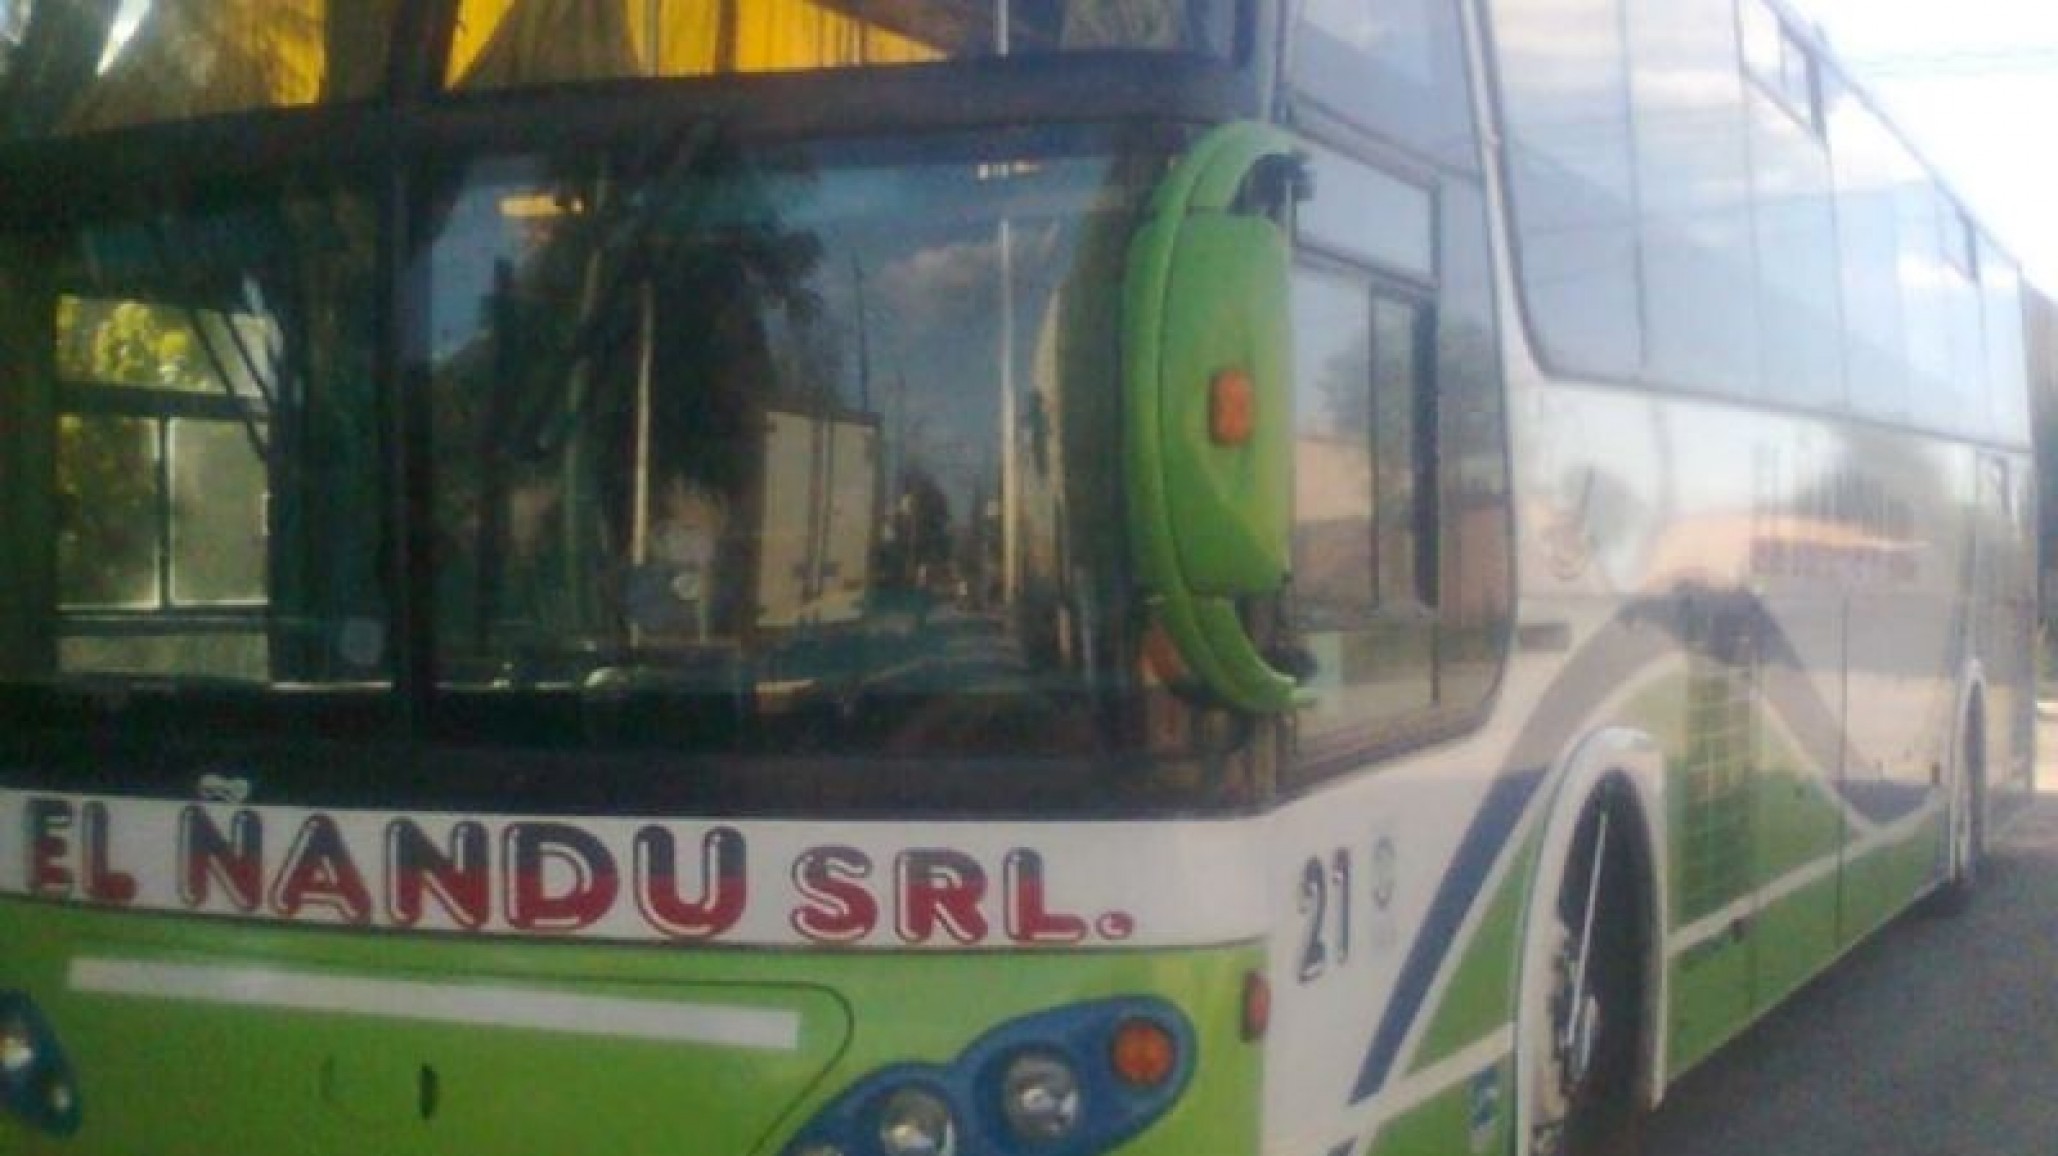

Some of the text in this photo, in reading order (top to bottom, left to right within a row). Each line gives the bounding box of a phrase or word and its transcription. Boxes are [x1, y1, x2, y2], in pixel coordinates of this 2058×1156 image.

[25, 776, 1135, 943] EL ÑANDU SRL.
[1296, 847, 1351, 985] 21
